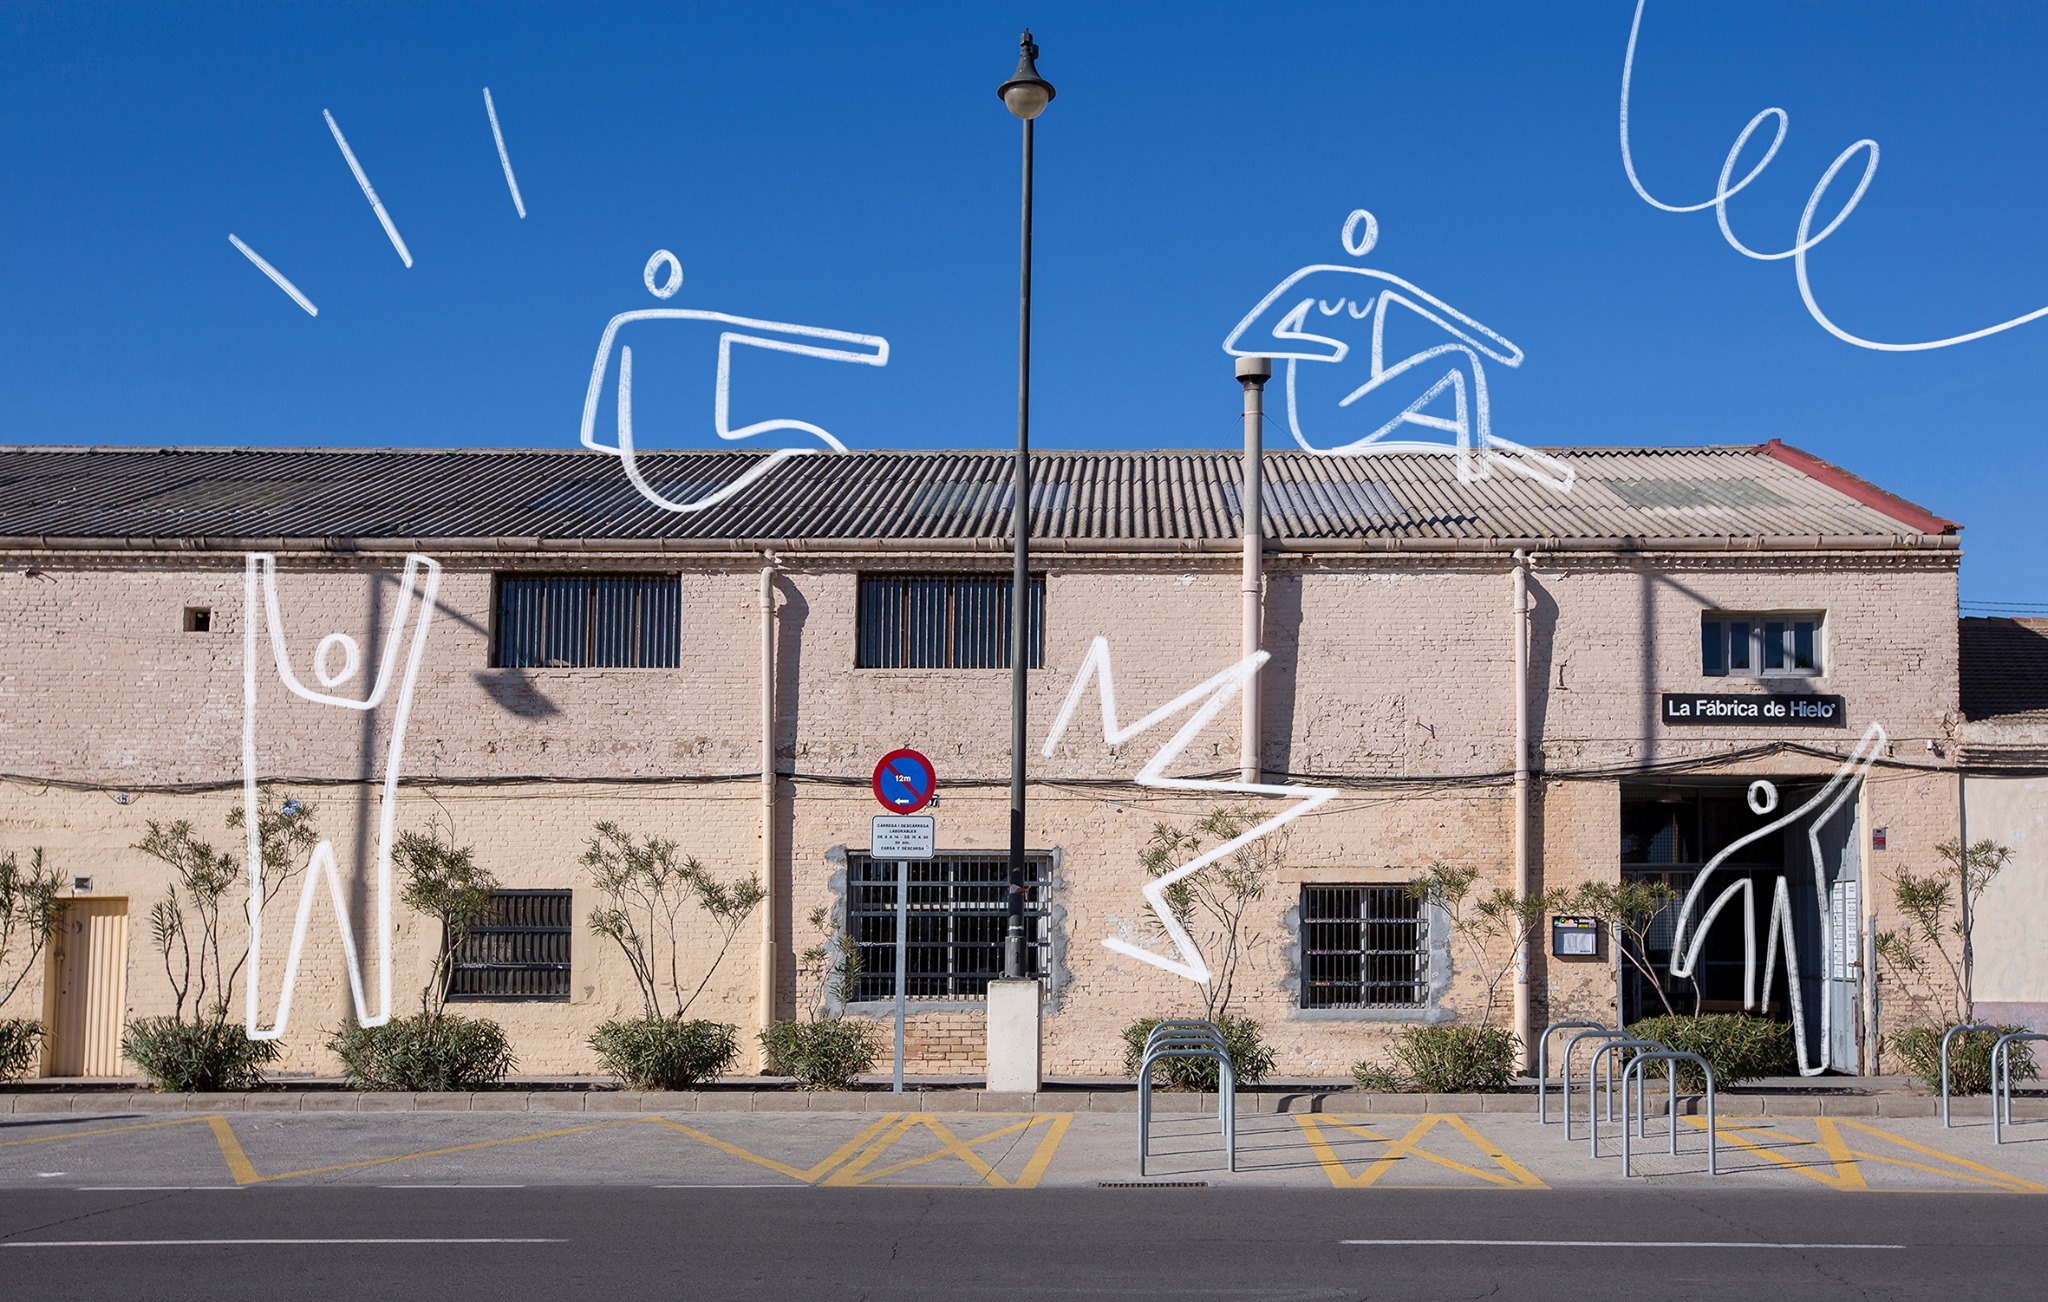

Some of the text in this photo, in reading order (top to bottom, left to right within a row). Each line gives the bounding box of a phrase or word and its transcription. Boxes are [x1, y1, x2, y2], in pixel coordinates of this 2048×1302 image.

[1668, 700, 1691, 716] La
[1696, 700, 1758, 716] Fábrica
[1763, 700, 1786, 717] de
[895, 774, 912, 782] 12m
